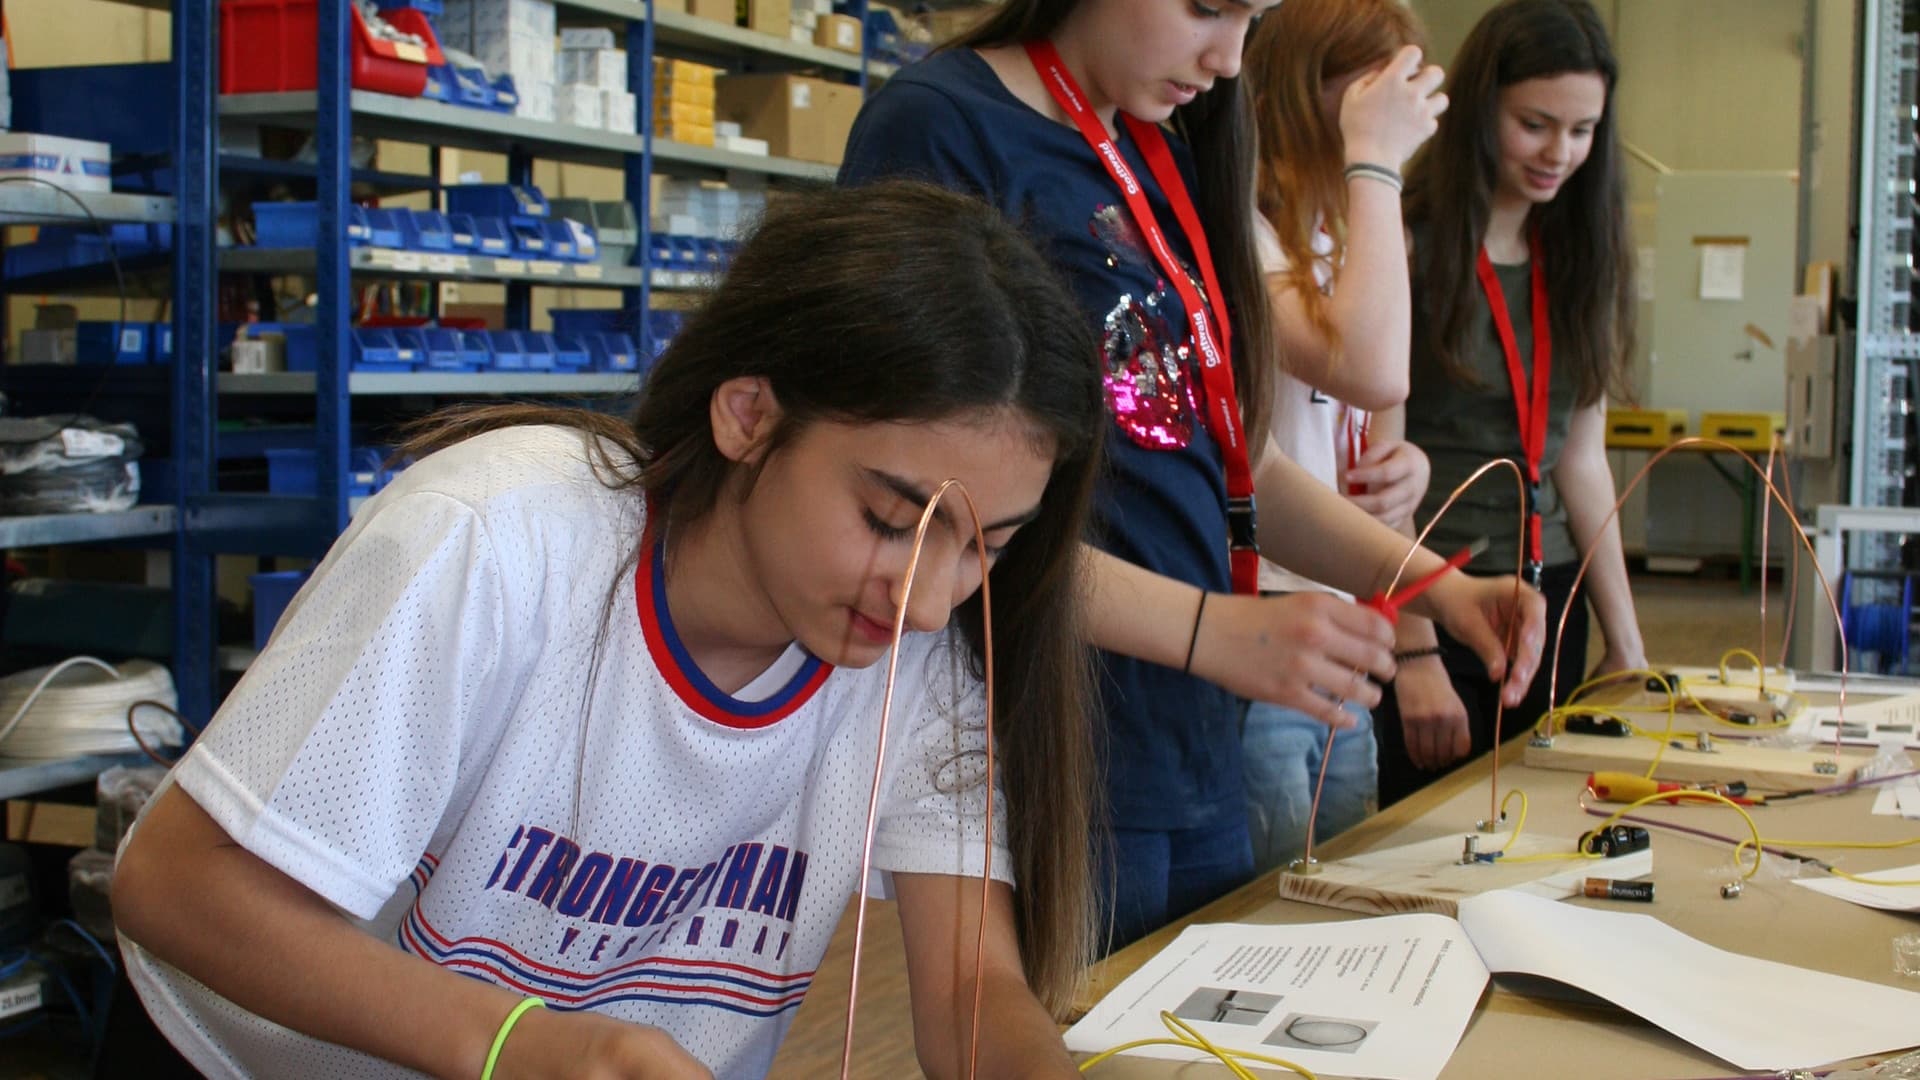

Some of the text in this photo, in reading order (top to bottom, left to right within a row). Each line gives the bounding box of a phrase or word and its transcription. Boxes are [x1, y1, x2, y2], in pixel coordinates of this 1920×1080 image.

[1098, 142, 1136, 194] Gottwald
[1193, 312, 1217, 367] Gottwald
[558, 916, 791, 961] YESRDAY
